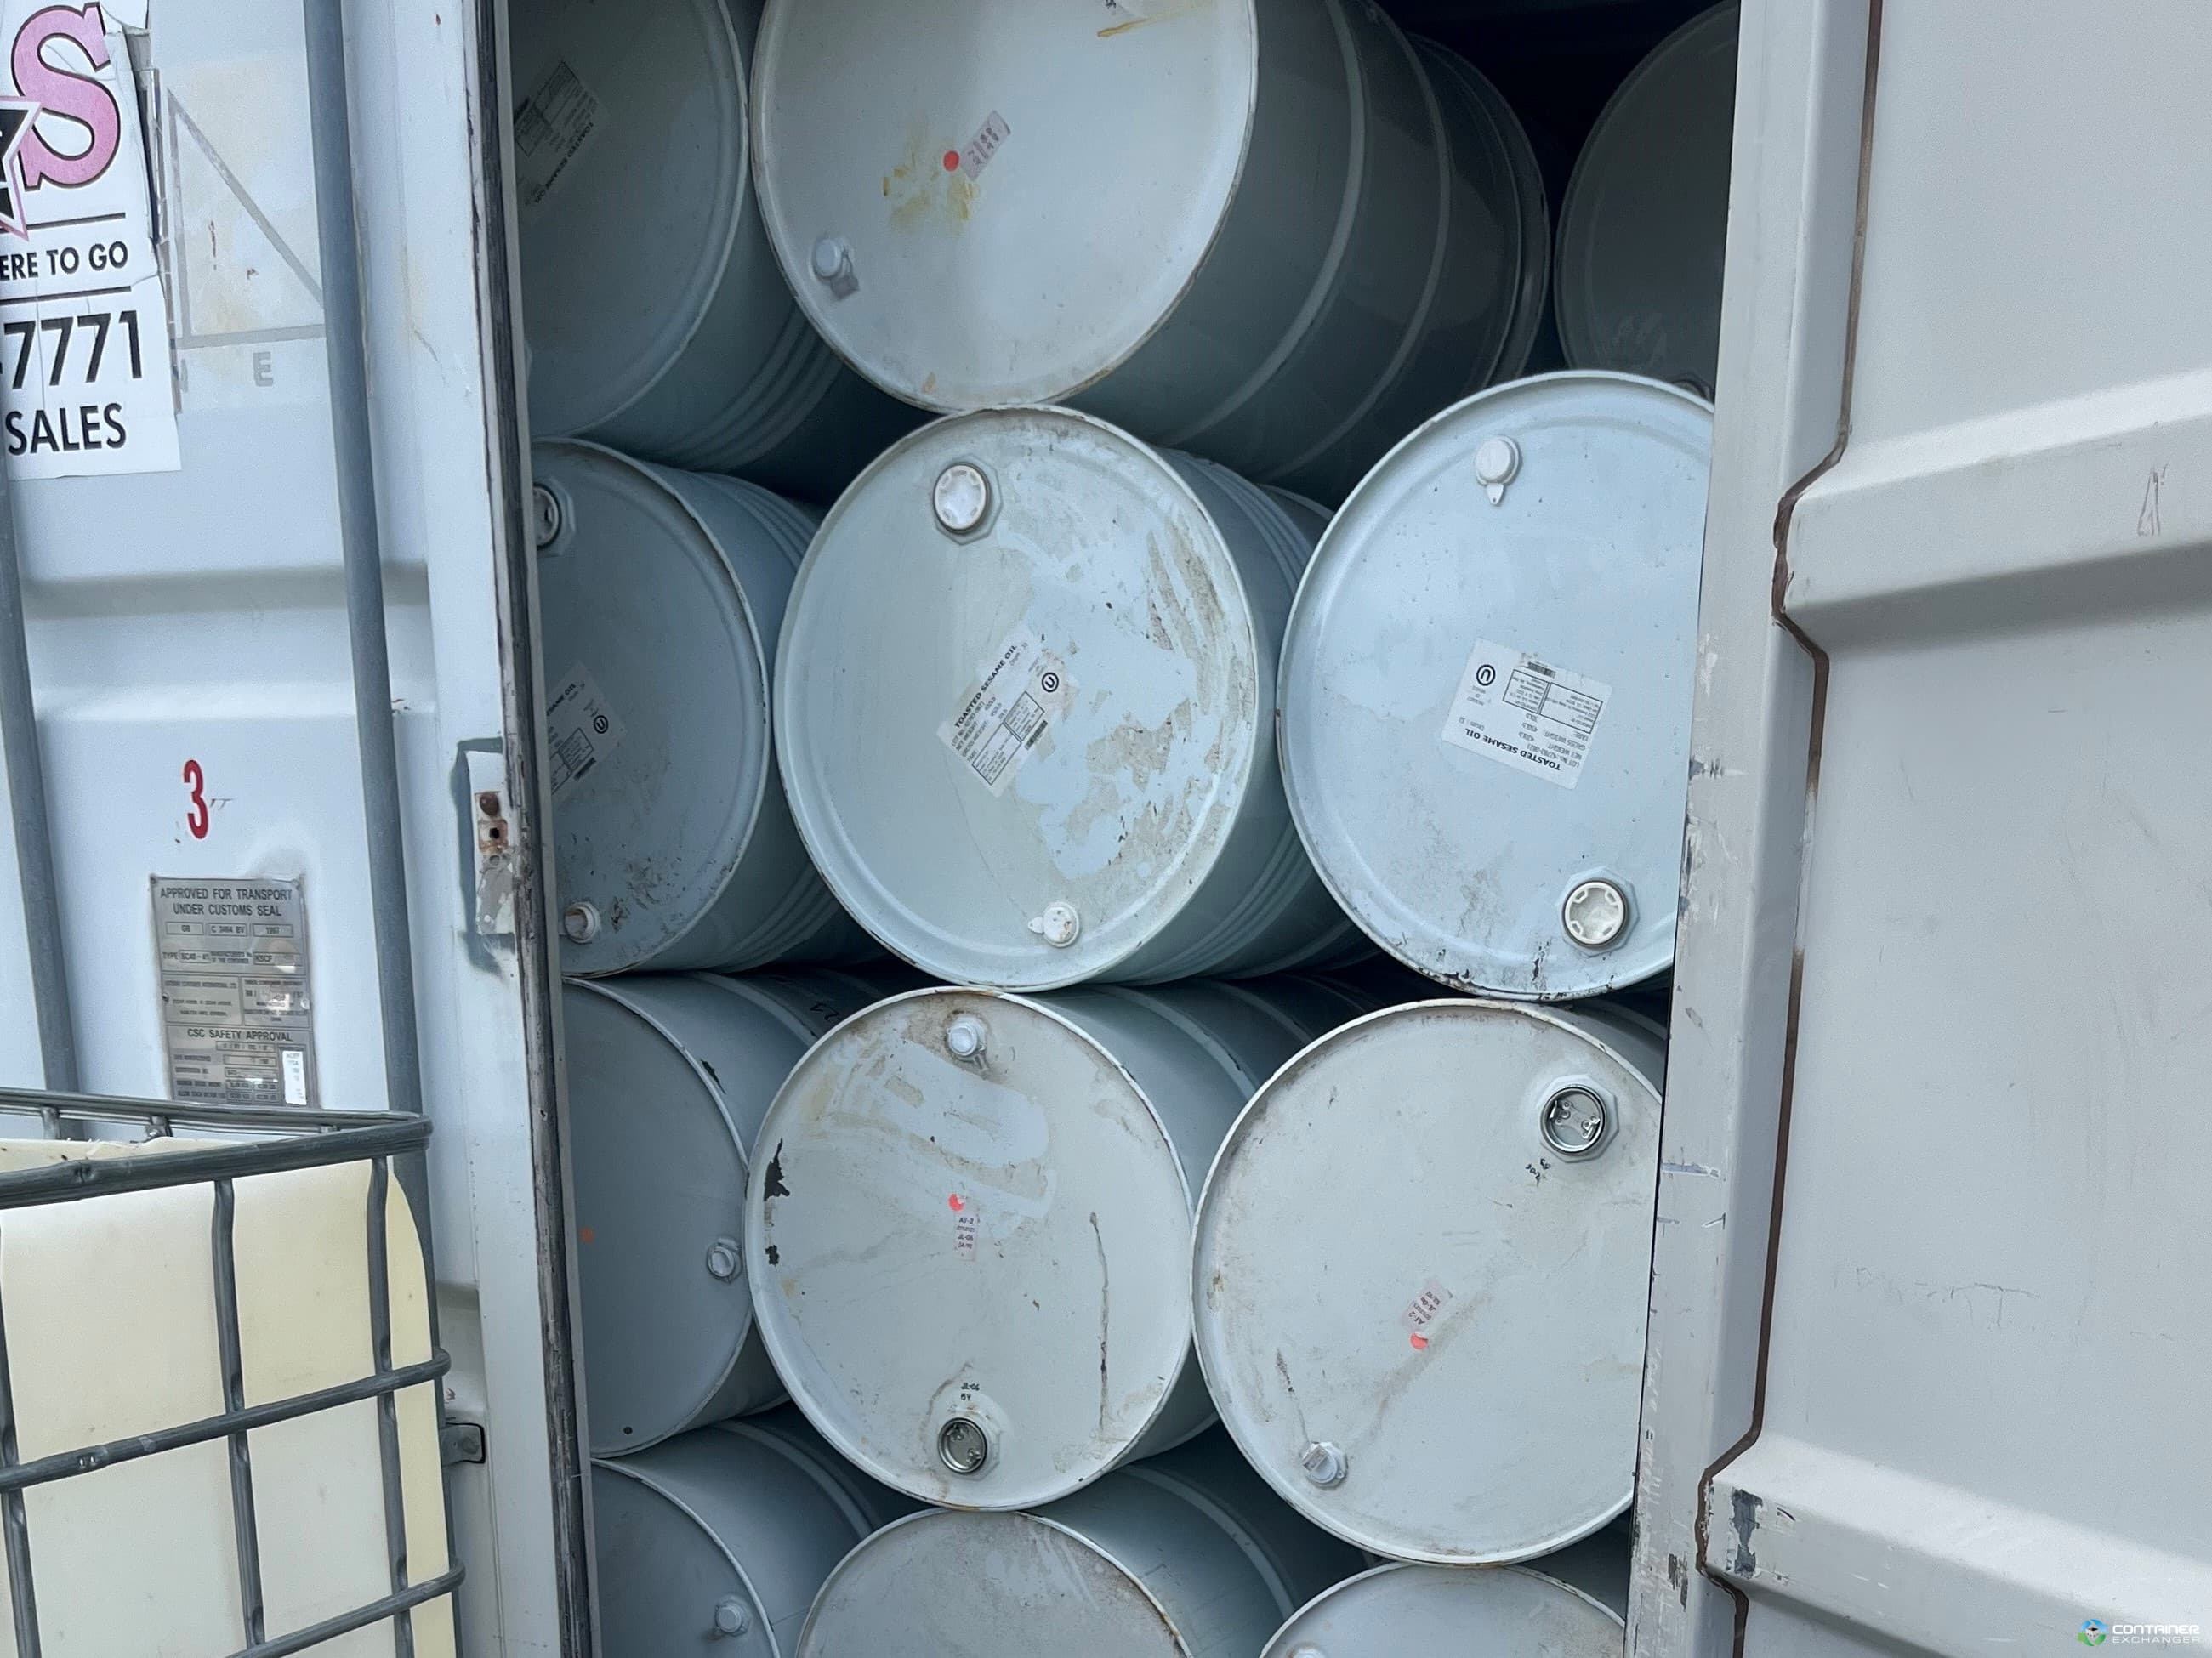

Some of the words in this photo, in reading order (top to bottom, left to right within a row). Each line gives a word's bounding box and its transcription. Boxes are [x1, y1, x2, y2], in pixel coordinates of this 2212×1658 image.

[46, 247, 80, 273] TO
[89, 241, 128, 270] GO
[0, 310, 142, 390] 7771
[5, 402, 127, 456] SALES
[954, 692, 982, 729] TOASTED
[981, 659, 1005, 692] SESAME
[1004, 644, 1018, 660] OIL
[1465, 728, 1481, 740] OIL
[1483, 735, 1518, 754] SESAME
[1520, 750, 1561, 771] TOASTED
[184, 759, 208, 839] 3
[160, 888, 208, 899] APPROVED
[213, 889, 232, 900] FOR
[236, 889, 293, 900] TRANSPORT
[173, 903, 204, 915] UNDER
[208, 904, 253, 916] CUSTOMS
[257, 905, 282, 917] SEAL
[188, 1028, 205, 1038] CSC
[209, 1029, 242, 1039] SAFETY
[246, 1031, 293, 1042] APPROVAL
